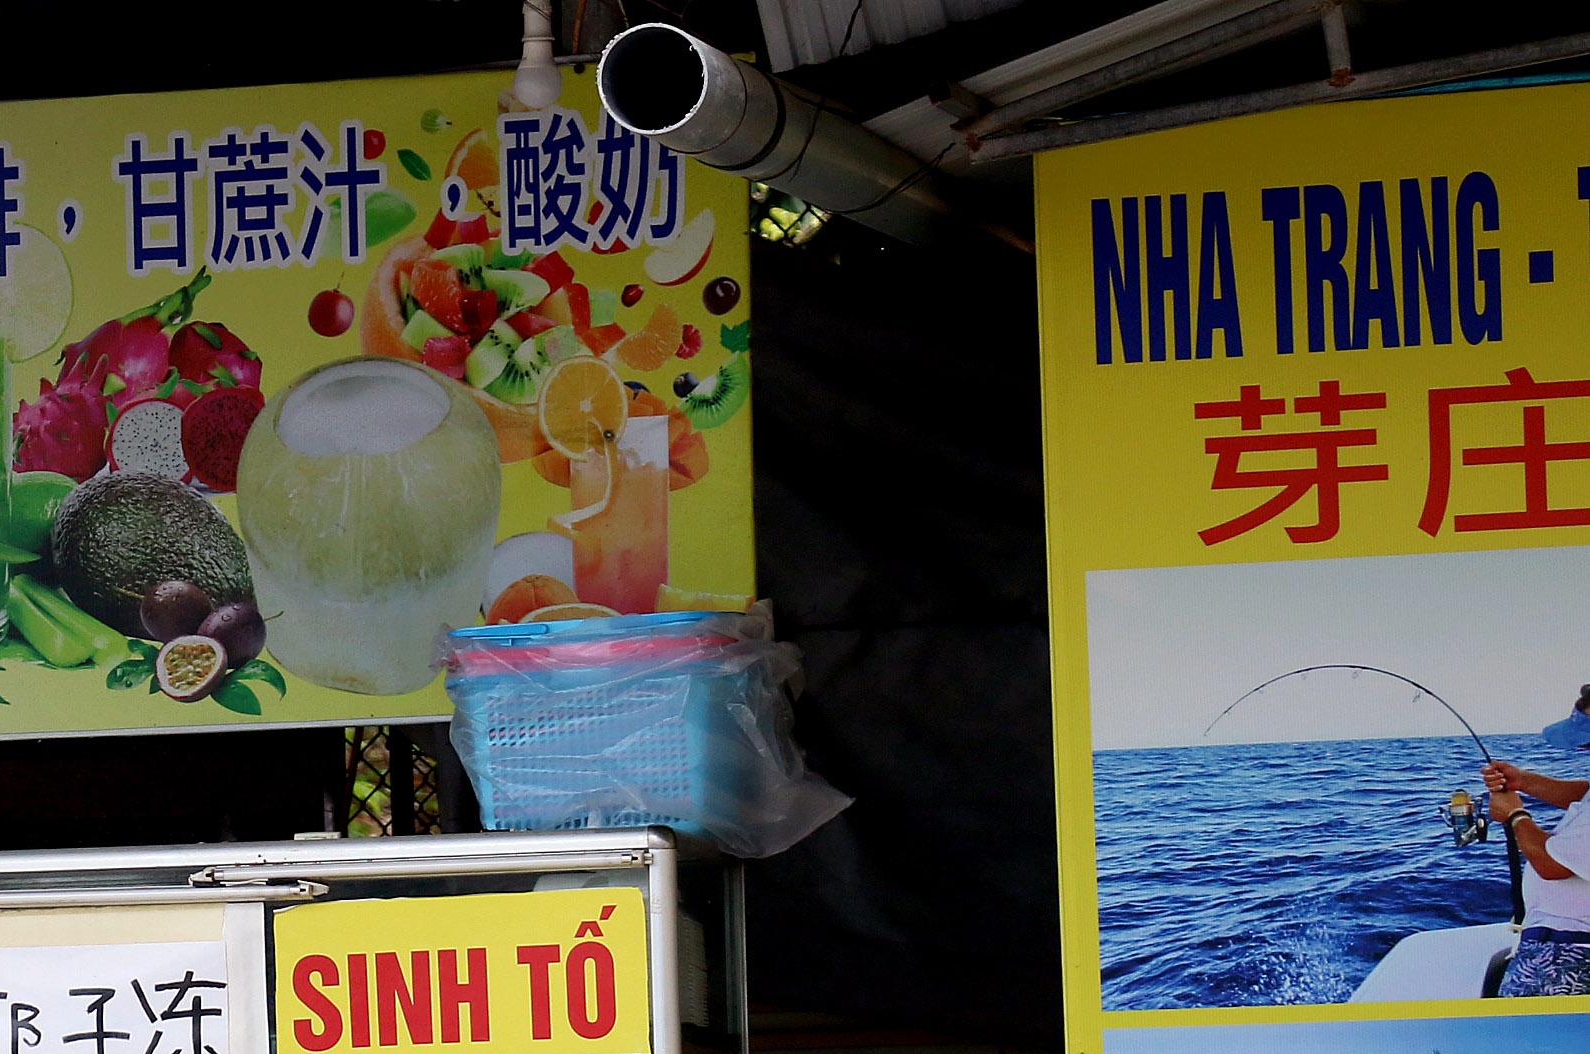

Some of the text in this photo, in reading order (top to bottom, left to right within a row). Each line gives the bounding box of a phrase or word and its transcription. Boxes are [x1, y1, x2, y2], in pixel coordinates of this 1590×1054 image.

[1091, 191, 1243, 365] NHA
[1261, 171, 1502, 355] TRANG
[1193, 366, 1590, 547] 芽庄
[292, 904, 617, 1052] SINH TỐ
